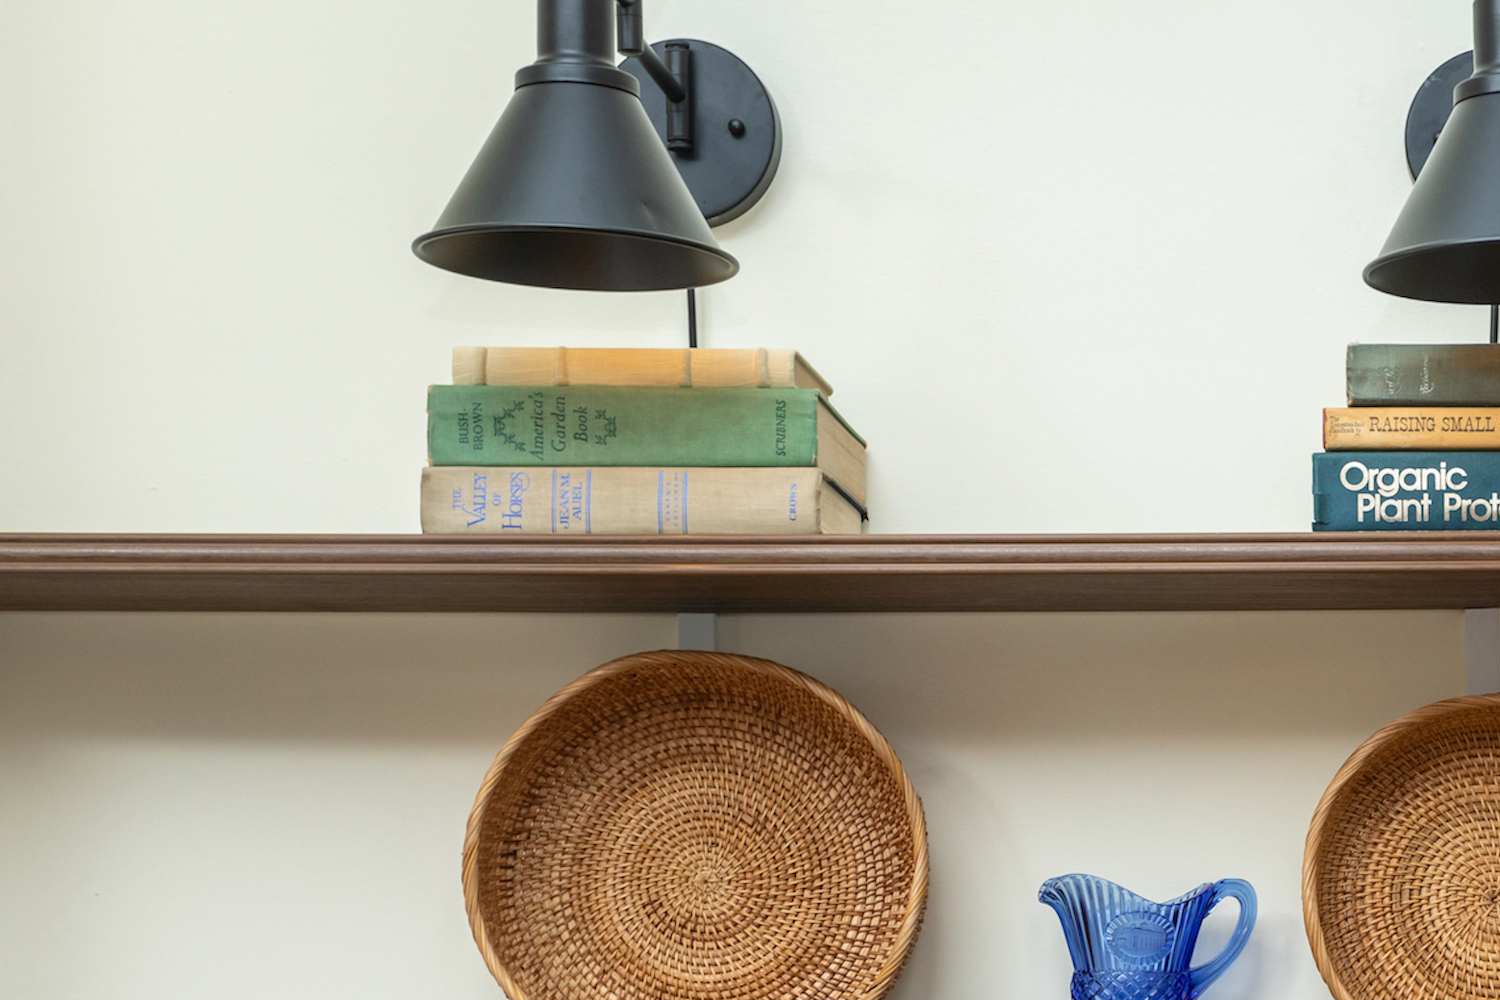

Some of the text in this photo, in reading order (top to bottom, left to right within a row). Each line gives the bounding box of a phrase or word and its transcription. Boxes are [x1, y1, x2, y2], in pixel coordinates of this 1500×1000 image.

[458, 408, 470, 444] BUSH-
[472, 402, 484, 451] BROWN
[529, 391, 545, 461] America's
[551, 396, 567, 453] Garden
[573, 405, 588, 442] Book
[775, 399, 787, 457] SCRIBNERS
[1369, 416, 1436, 433] RAISING
[1441, 415, 1495, 433] SMALL
[1339, 461, 1468, 497] Organic
[572, 481, 583, 521] AUEL
[1357, 493, 1432, 522] Plant
